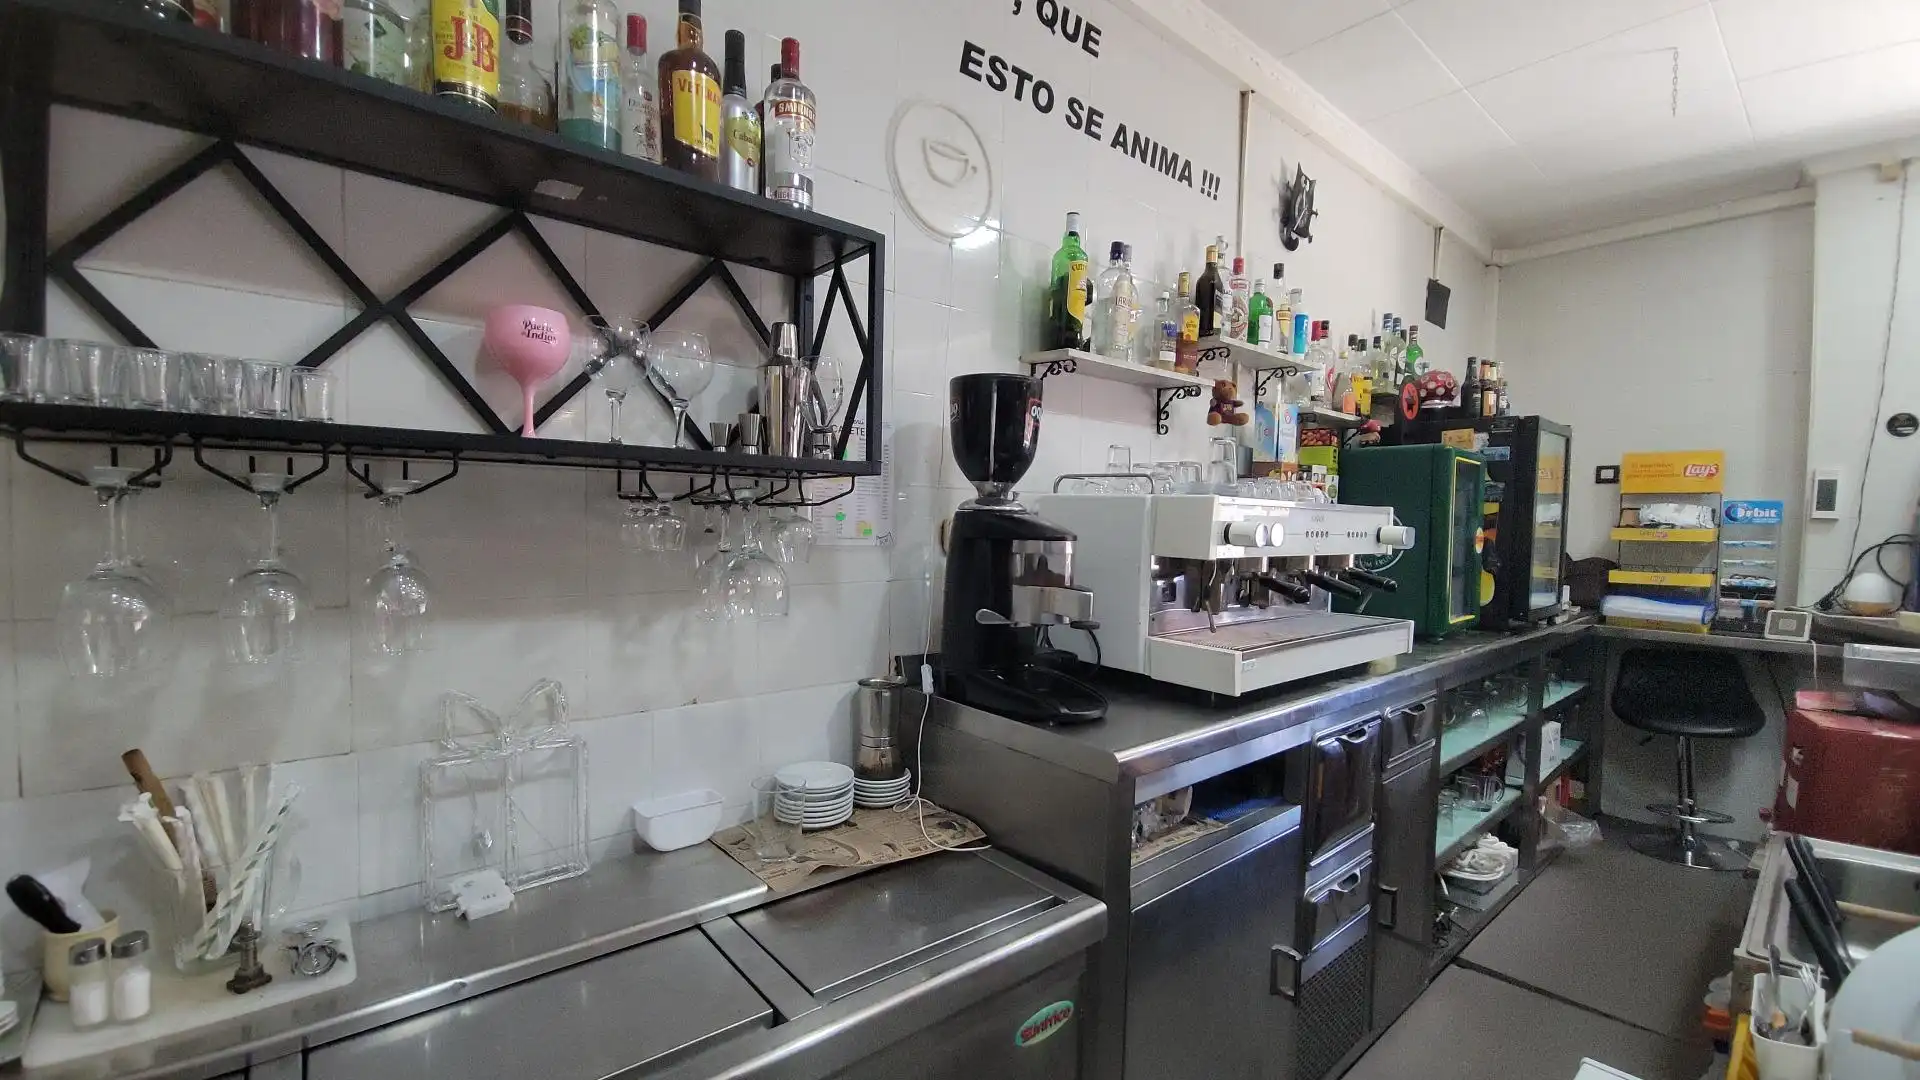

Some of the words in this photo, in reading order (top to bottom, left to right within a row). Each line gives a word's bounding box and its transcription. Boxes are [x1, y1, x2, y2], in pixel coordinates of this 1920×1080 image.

[1036, 0, 1102, 58] QUE
[959, 40, 1055, 114] ESTO
[1065, 96, 1104, 141] SE
[1110, 122, 1193, 188] ANIMA
